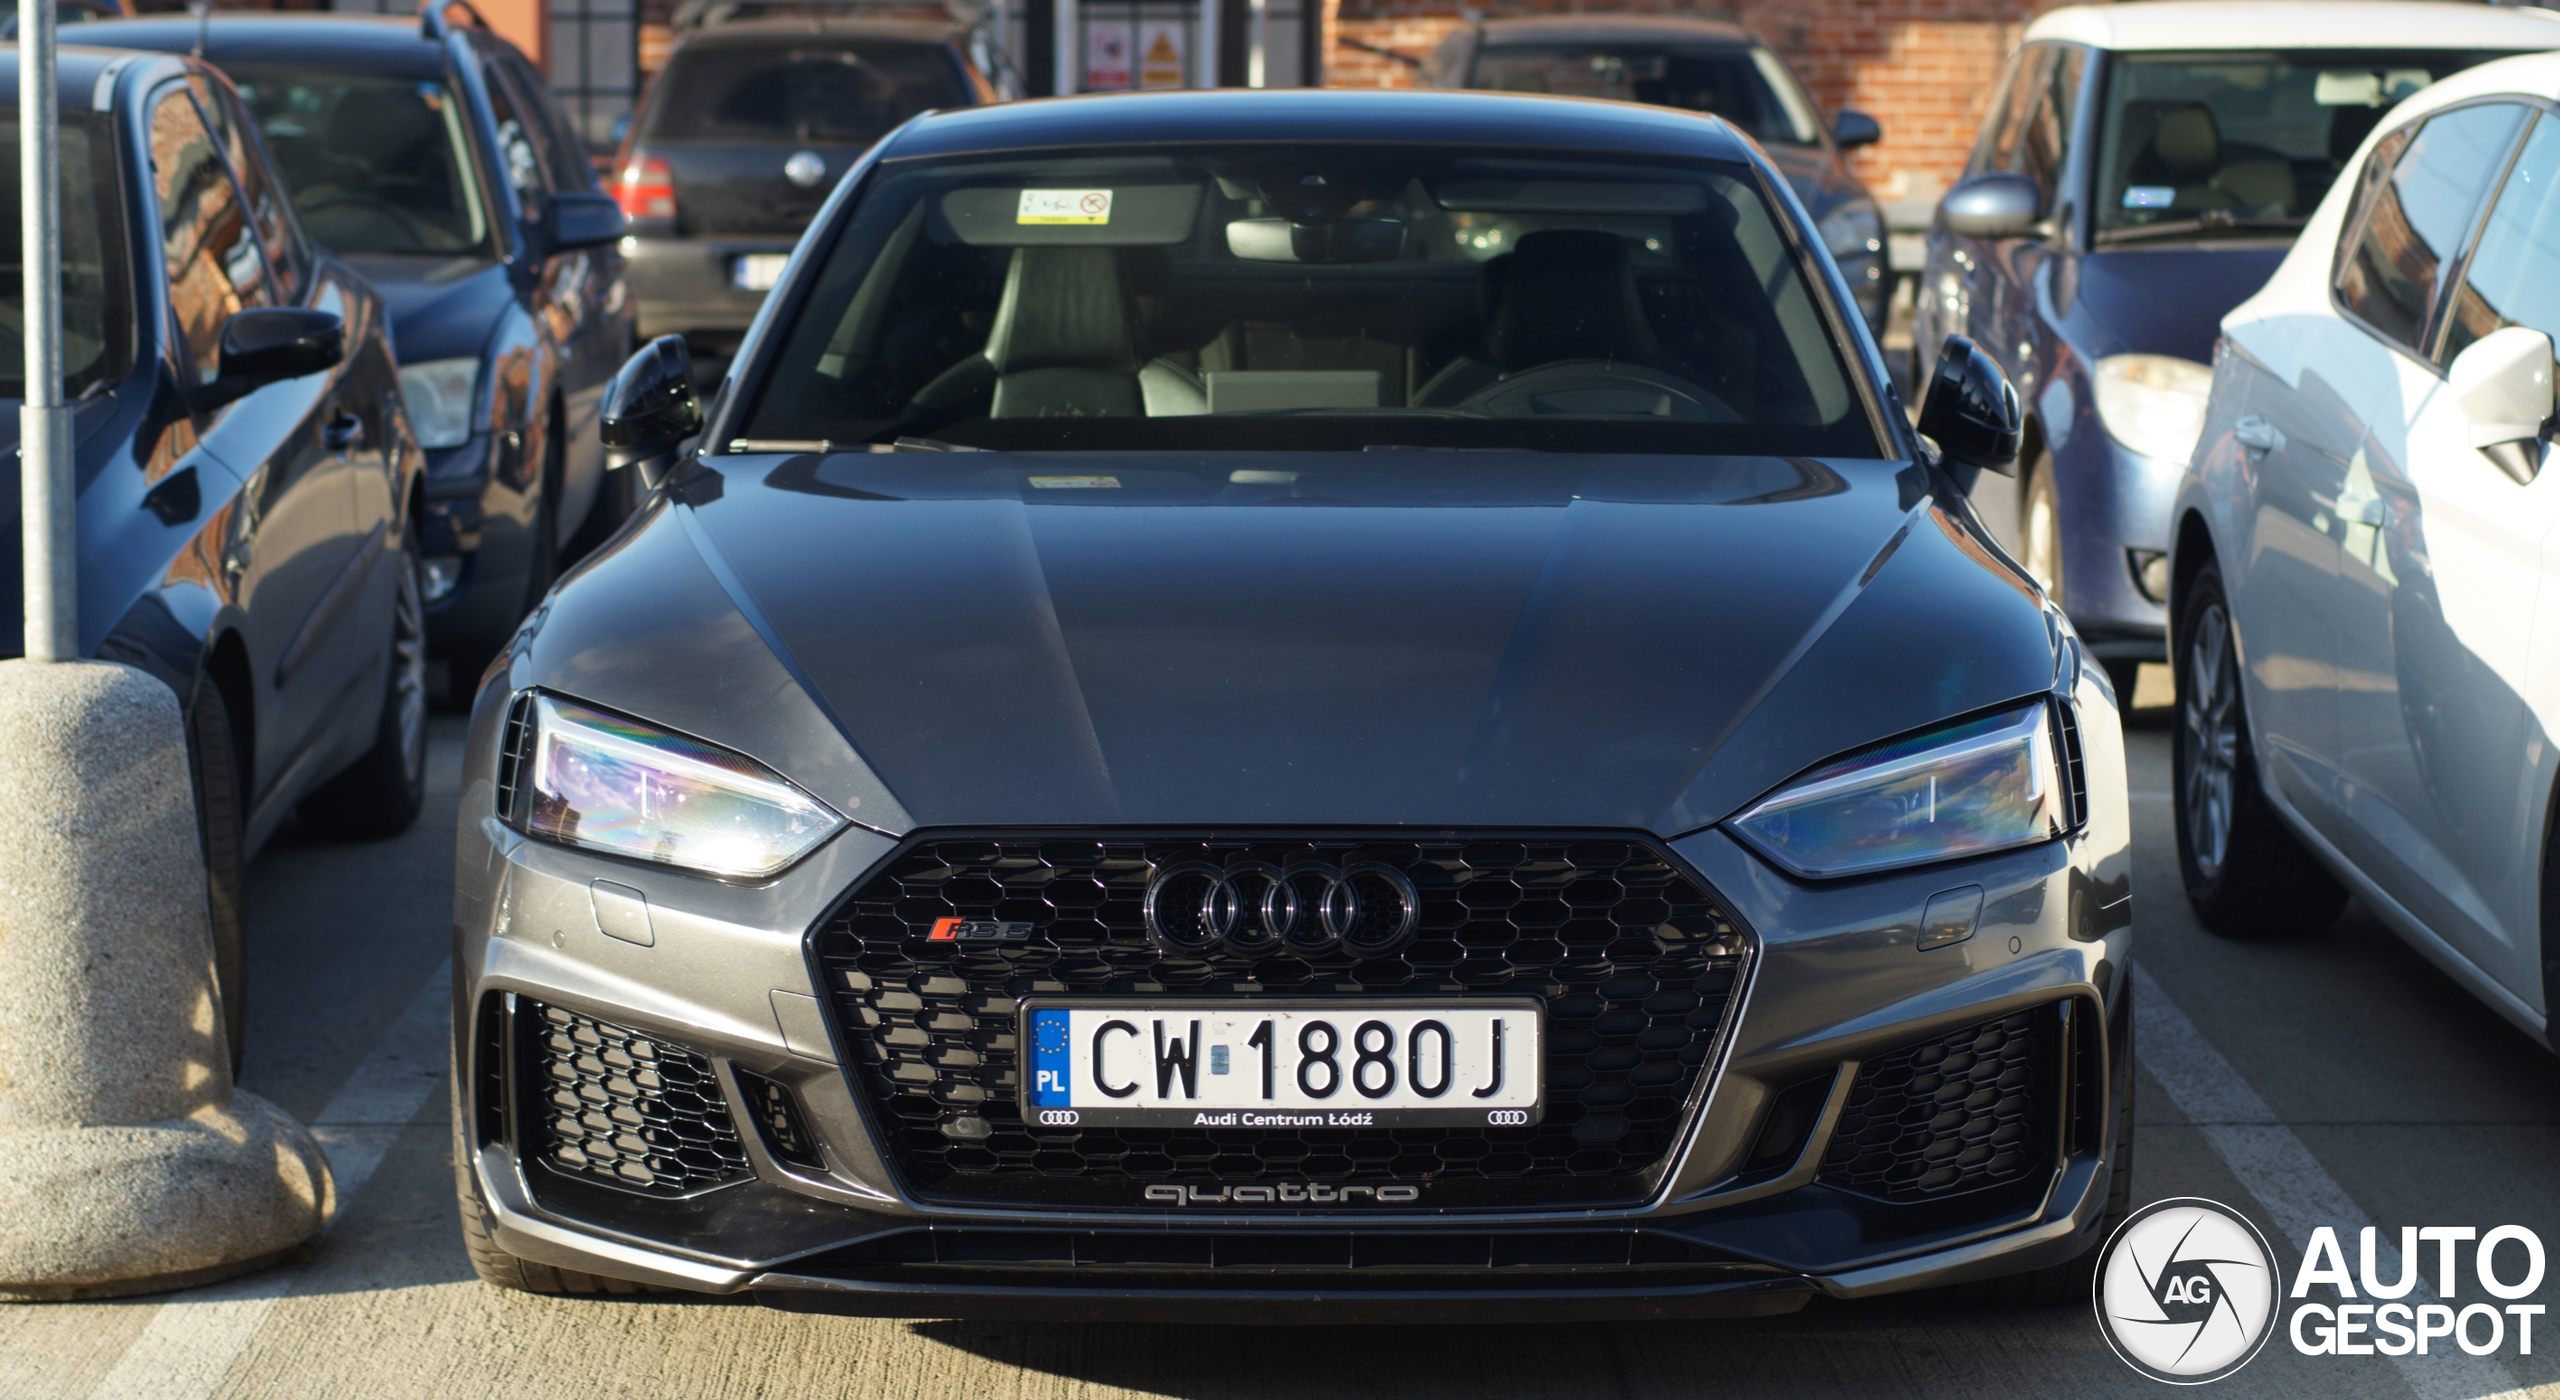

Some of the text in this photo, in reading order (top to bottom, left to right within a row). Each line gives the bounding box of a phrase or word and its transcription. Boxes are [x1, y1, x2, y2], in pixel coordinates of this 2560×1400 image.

[1004, 922, 1031, 939] 5
[1092, 1019, 1503, 1100] CW 1880J
[1036, 1070, 1066, 1092] PL
[1193, 1111, 1373, 1126] Audi Centrum Łódź
[1144, 1182, 1419, 1206] quattro
